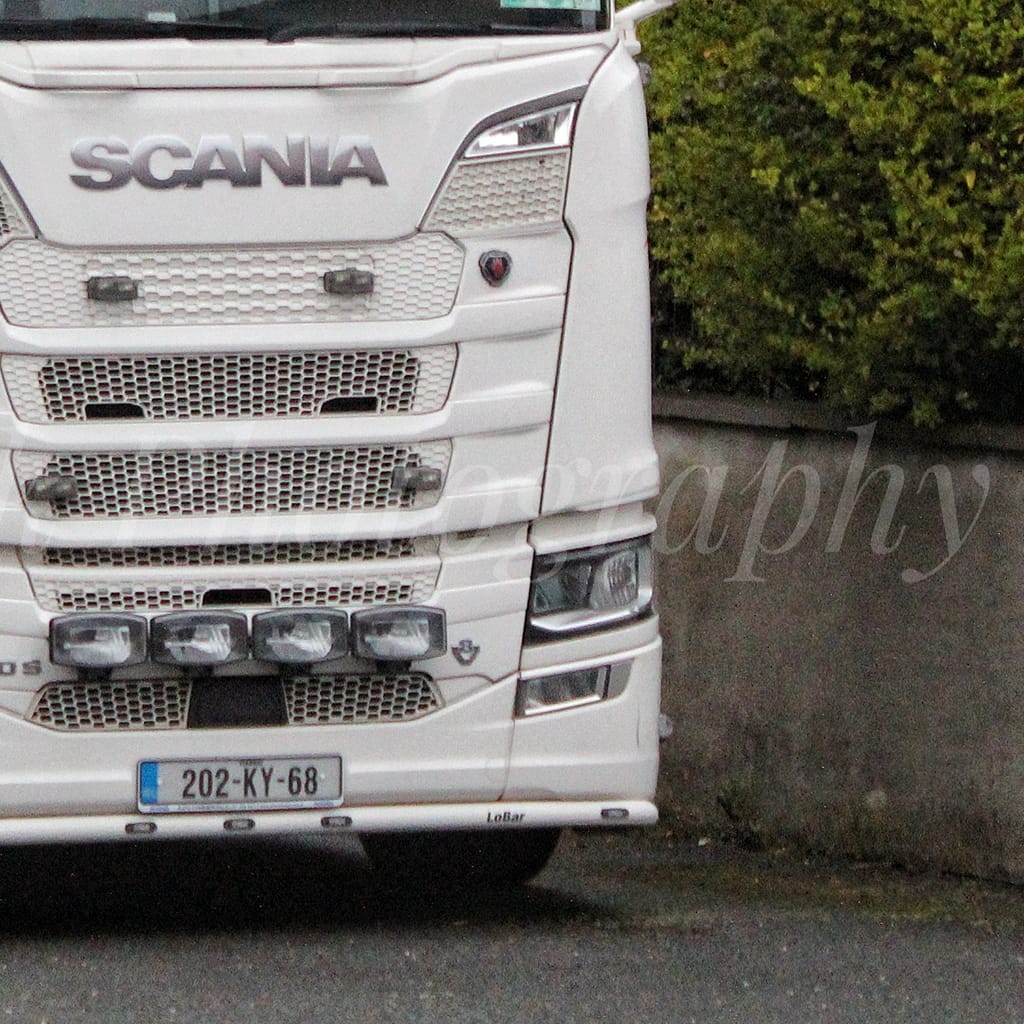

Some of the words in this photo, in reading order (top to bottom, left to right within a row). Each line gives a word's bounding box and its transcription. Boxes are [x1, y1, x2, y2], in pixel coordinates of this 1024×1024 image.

[68, 134, 390, 191] SCANIA
[22, 659, 43, 676] S
[182, 766, 319, 800] 202-KY-68
[486, 811, 526, 824] LoBar
